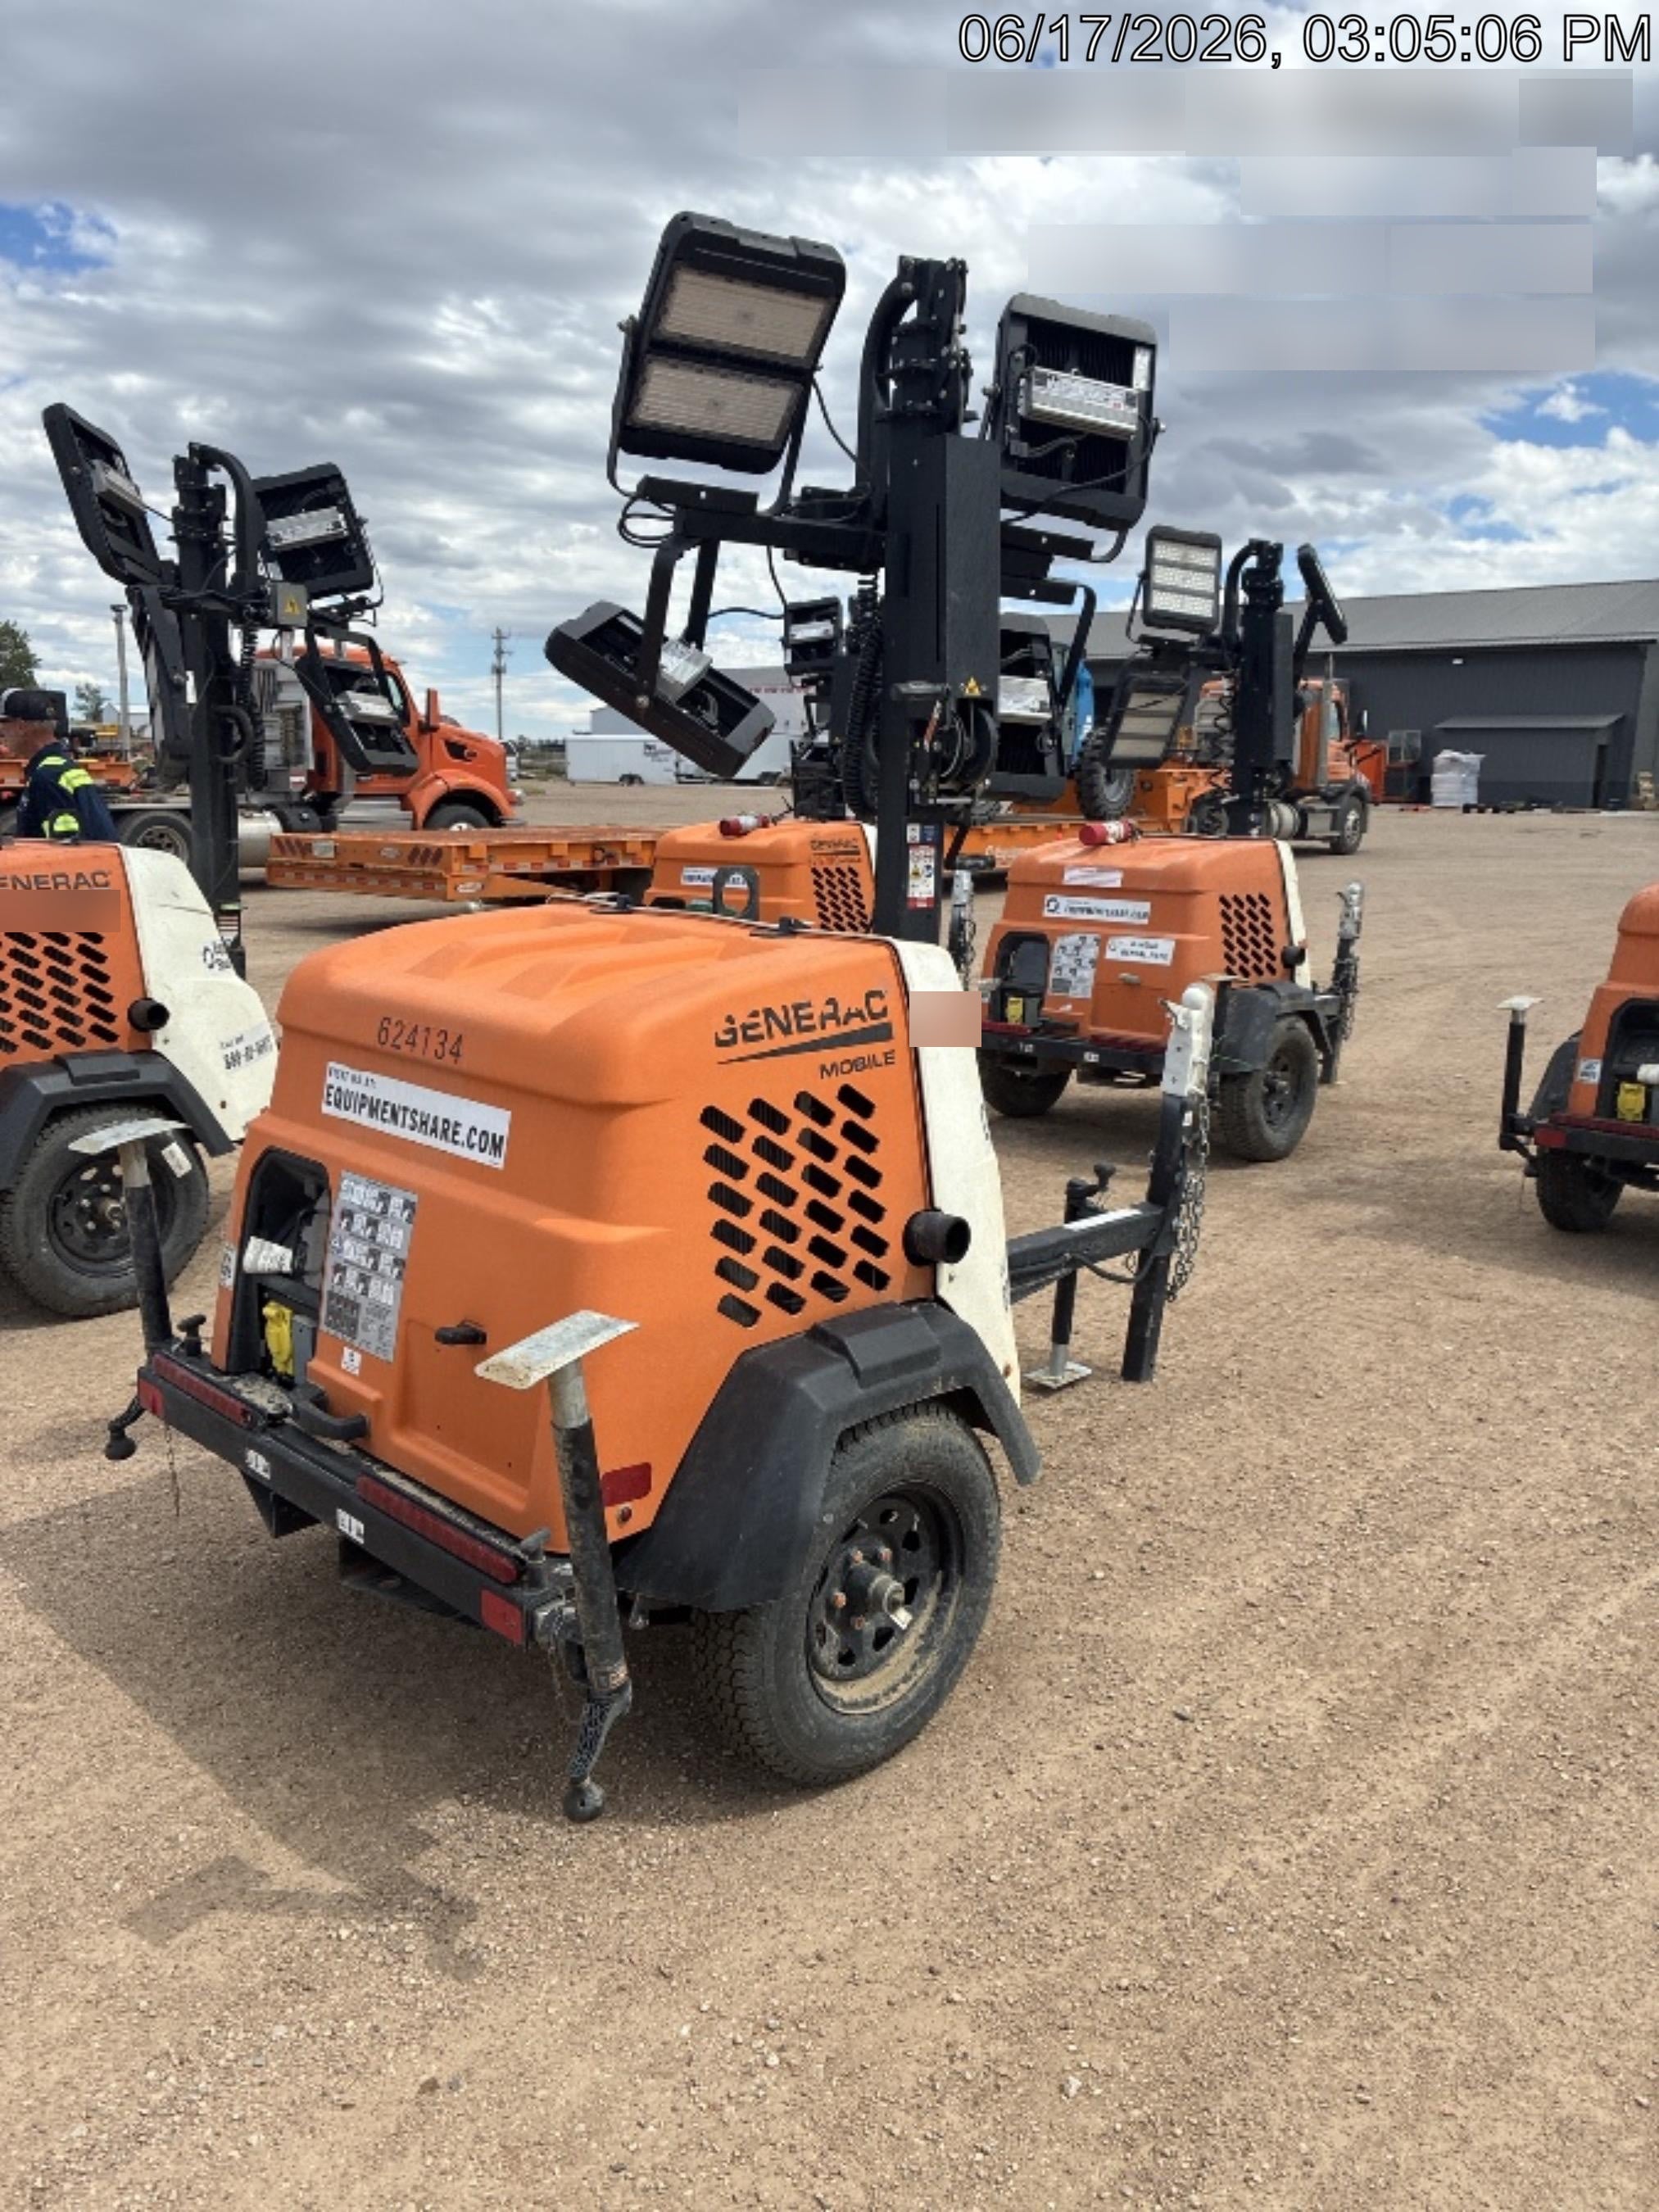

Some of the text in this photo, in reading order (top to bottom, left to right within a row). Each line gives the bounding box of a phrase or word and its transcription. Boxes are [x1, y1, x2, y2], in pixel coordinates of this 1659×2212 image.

[377, 1016, 464, 1064] 624134
[714, 990, 888, 1047] GENERAC
[820, 1049, 895, 1079] MOBILE
[325, 1084, 505, 1158] EQUIPMENTSHARE.COM
